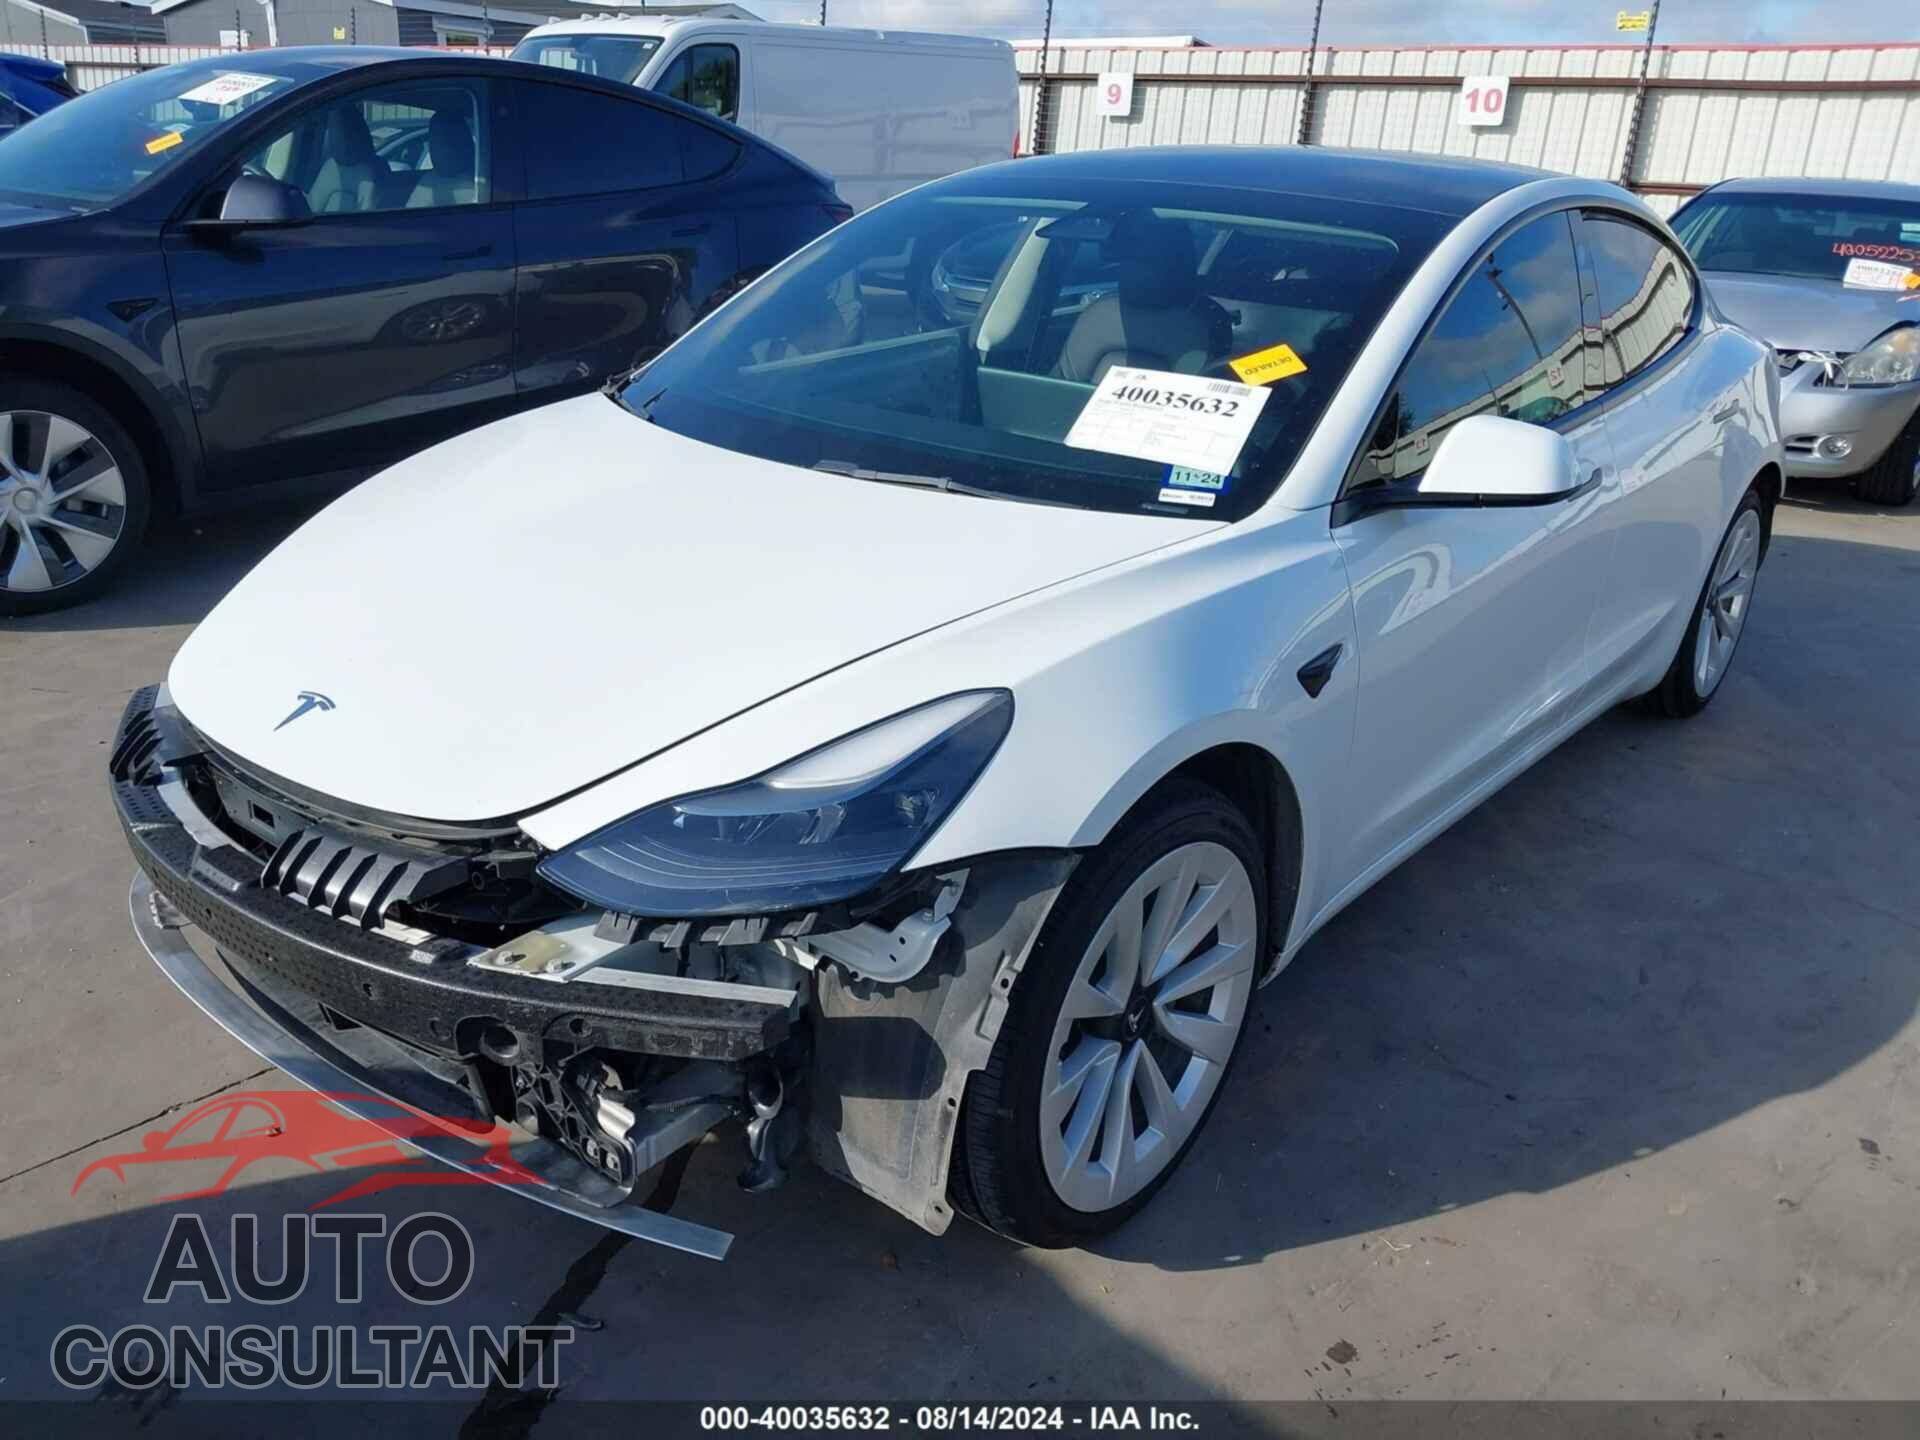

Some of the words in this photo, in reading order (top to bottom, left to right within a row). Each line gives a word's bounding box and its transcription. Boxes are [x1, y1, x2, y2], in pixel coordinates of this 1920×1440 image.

[1107, 83, 1121, 105] 9
[1465, 87, 1503, 113] 10
[1111, 385, 1239, 417] 40035632
[1175, 471, 1191, 481] 11
[1201, 472, 1221, 484] 24
